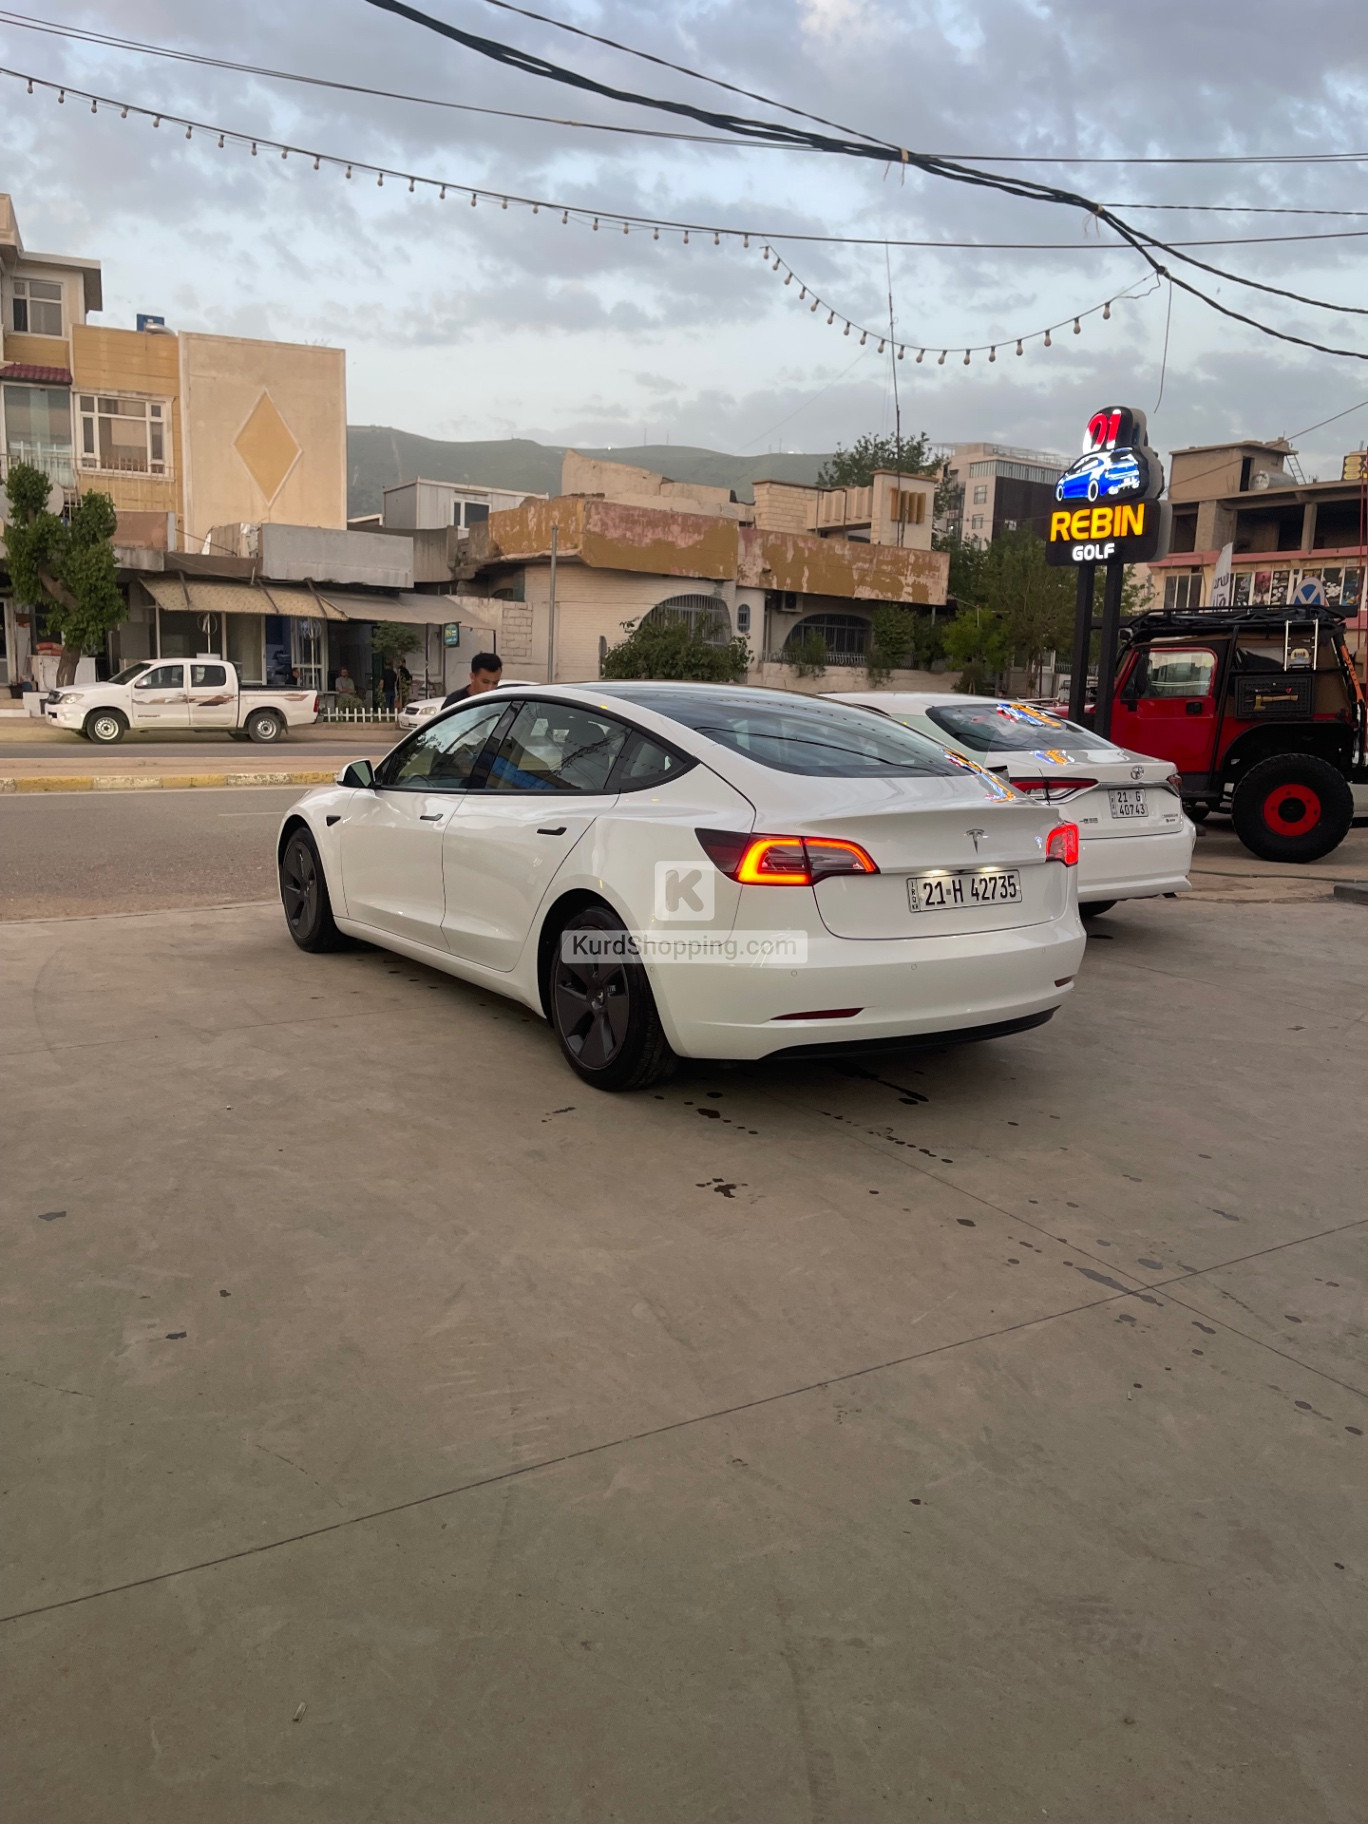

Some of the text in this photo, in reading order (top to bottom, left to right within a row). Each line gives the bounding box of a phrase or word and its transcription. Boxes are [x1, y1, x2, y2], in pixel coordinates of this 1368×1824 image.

[1083, 409, 1122, 454] 01
[1050, 503, 1145, 542] REBIN
[1072, 543, 1116, 562] GOLF
[1117, 790, 1142, 803] 21 G
[1119, 803, 1146, 816] 40743
[971, 875, 1017, 901] 42735
